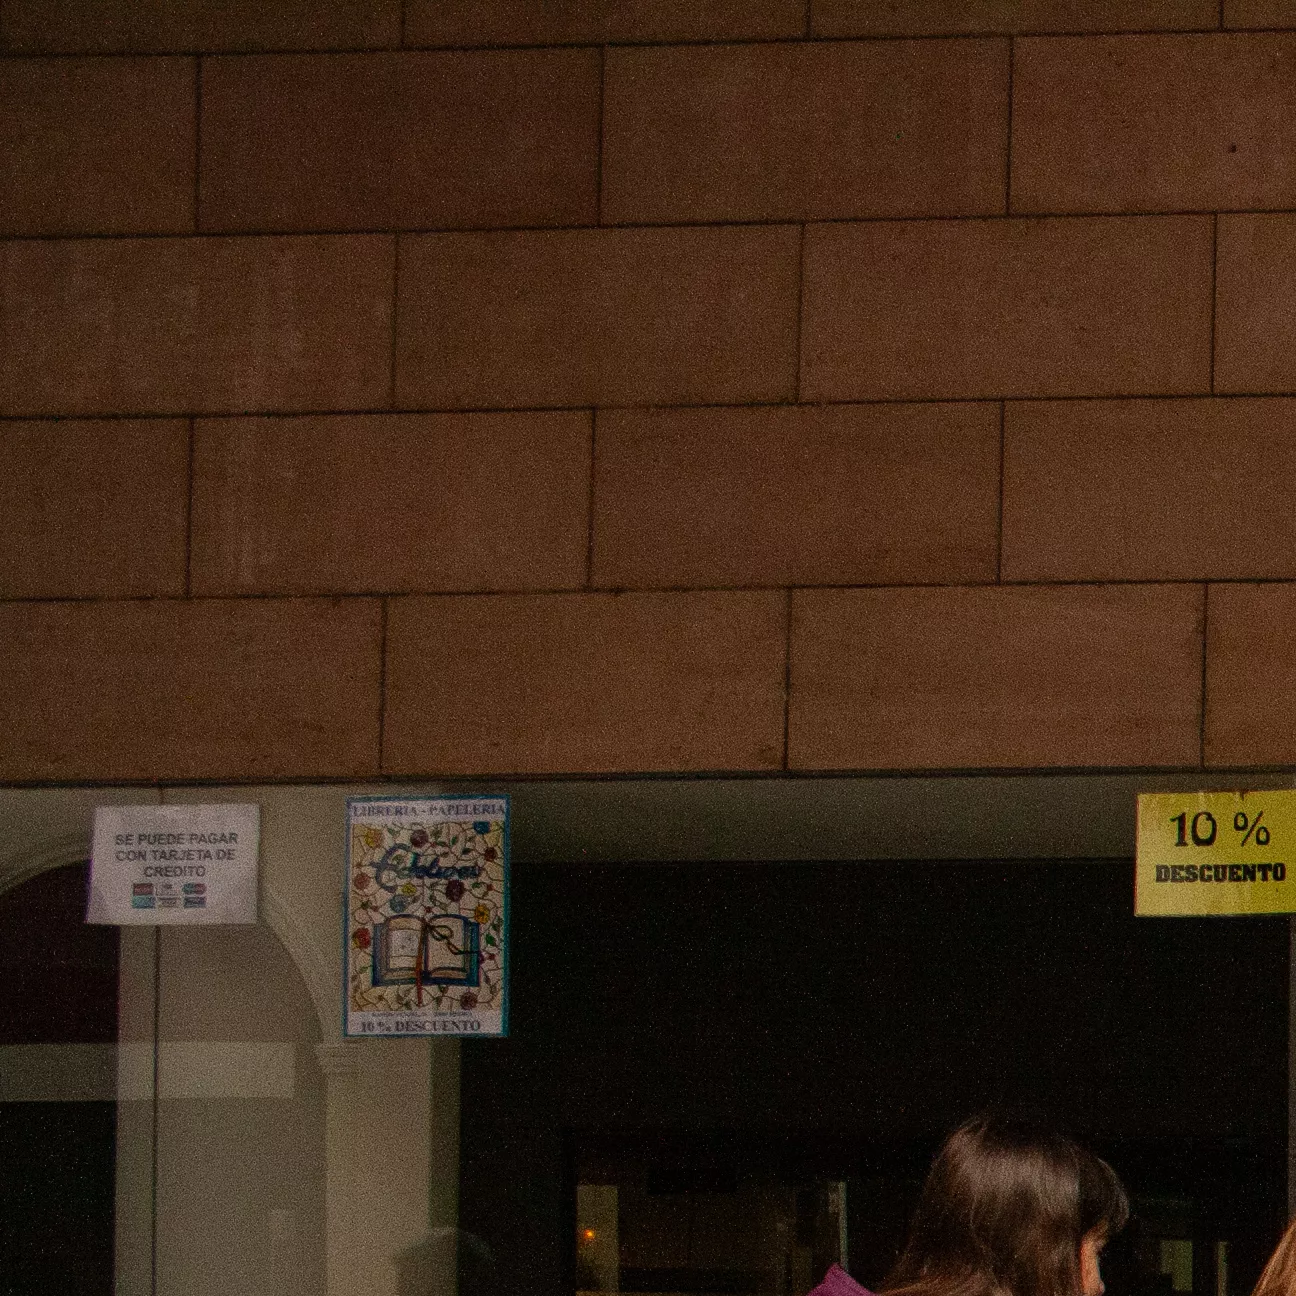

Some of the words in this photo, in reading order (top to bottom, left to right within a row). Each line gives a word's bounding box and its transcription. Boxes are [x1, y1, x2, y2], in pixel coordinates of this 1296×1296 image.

[1170, 811, 1217, 846] 10
[1234, 810, 1270, 847] %
[115, 833, 134, 846] SE
[138, 832, 185, 846] PUEDE
[190, 832, 238, 844] PAGAR
[116, 850, 147, 862] CON
[153, 849, 212, 861] TARJETA
[216, 848, 236, 860] DE
[1156, 862, 1286, 882] DESCUENTO
[361, 1021, 374, 1032] 10
[395, 1020, 481, 1032] DESCUENTO
